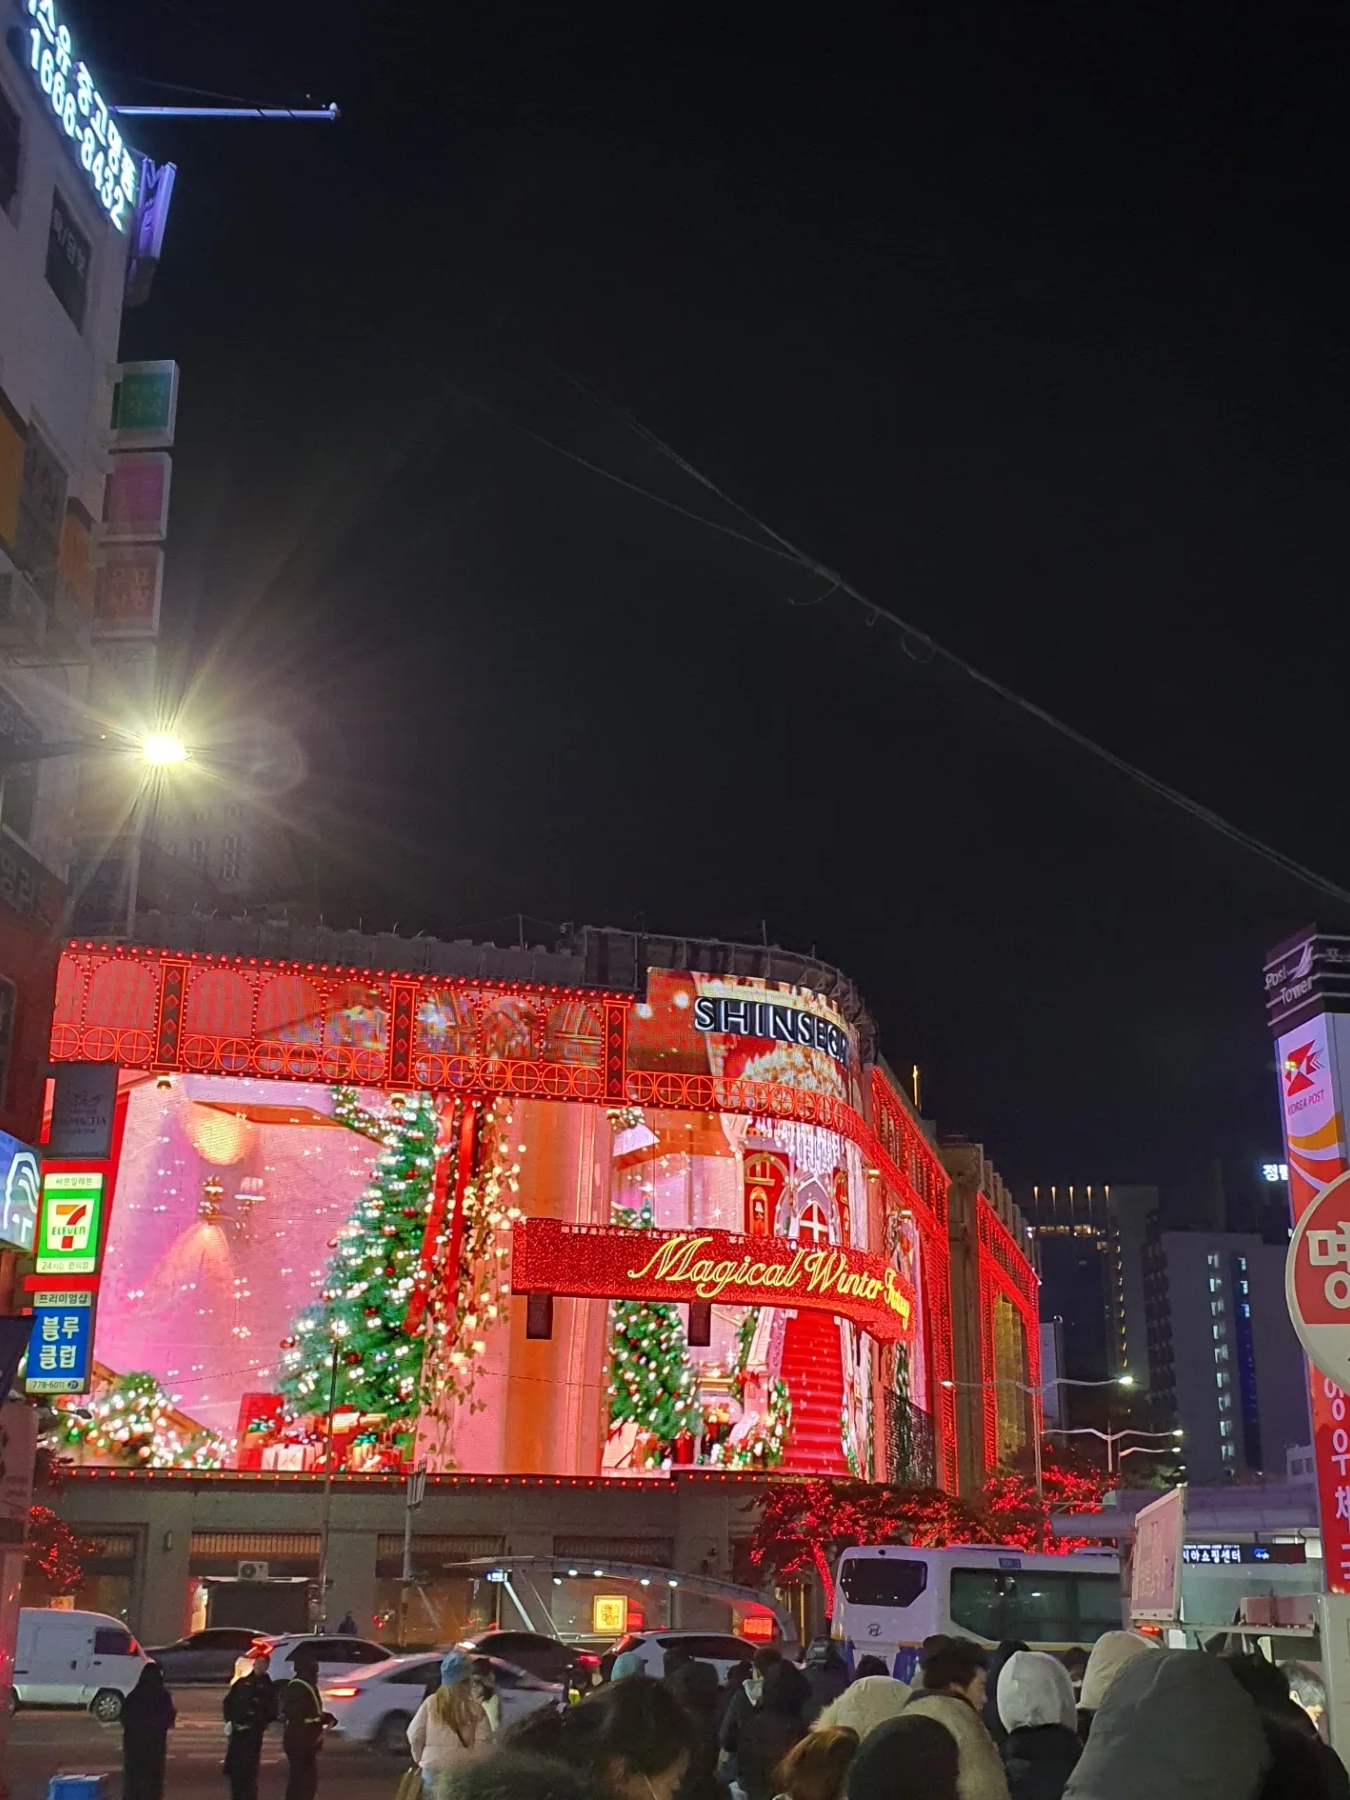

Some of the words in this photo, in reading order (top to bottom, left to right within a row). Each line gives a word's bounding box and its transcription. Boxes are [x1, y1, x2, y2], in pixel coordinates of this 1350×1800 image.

[1264, 964, 1287, 990] Post
[1280, 976, 1314, 1006] Tower
[1288, 1098, 1308, 1115] KOREA
[1308, 1089, 1324, 1106] POST
[628, 1236, 804, 1299] Magical
[802, 1250, 884, 1296] Winter
[42, 1316, 80, 1342] 블루
[39, 1345, 77, 1370] 클럽
